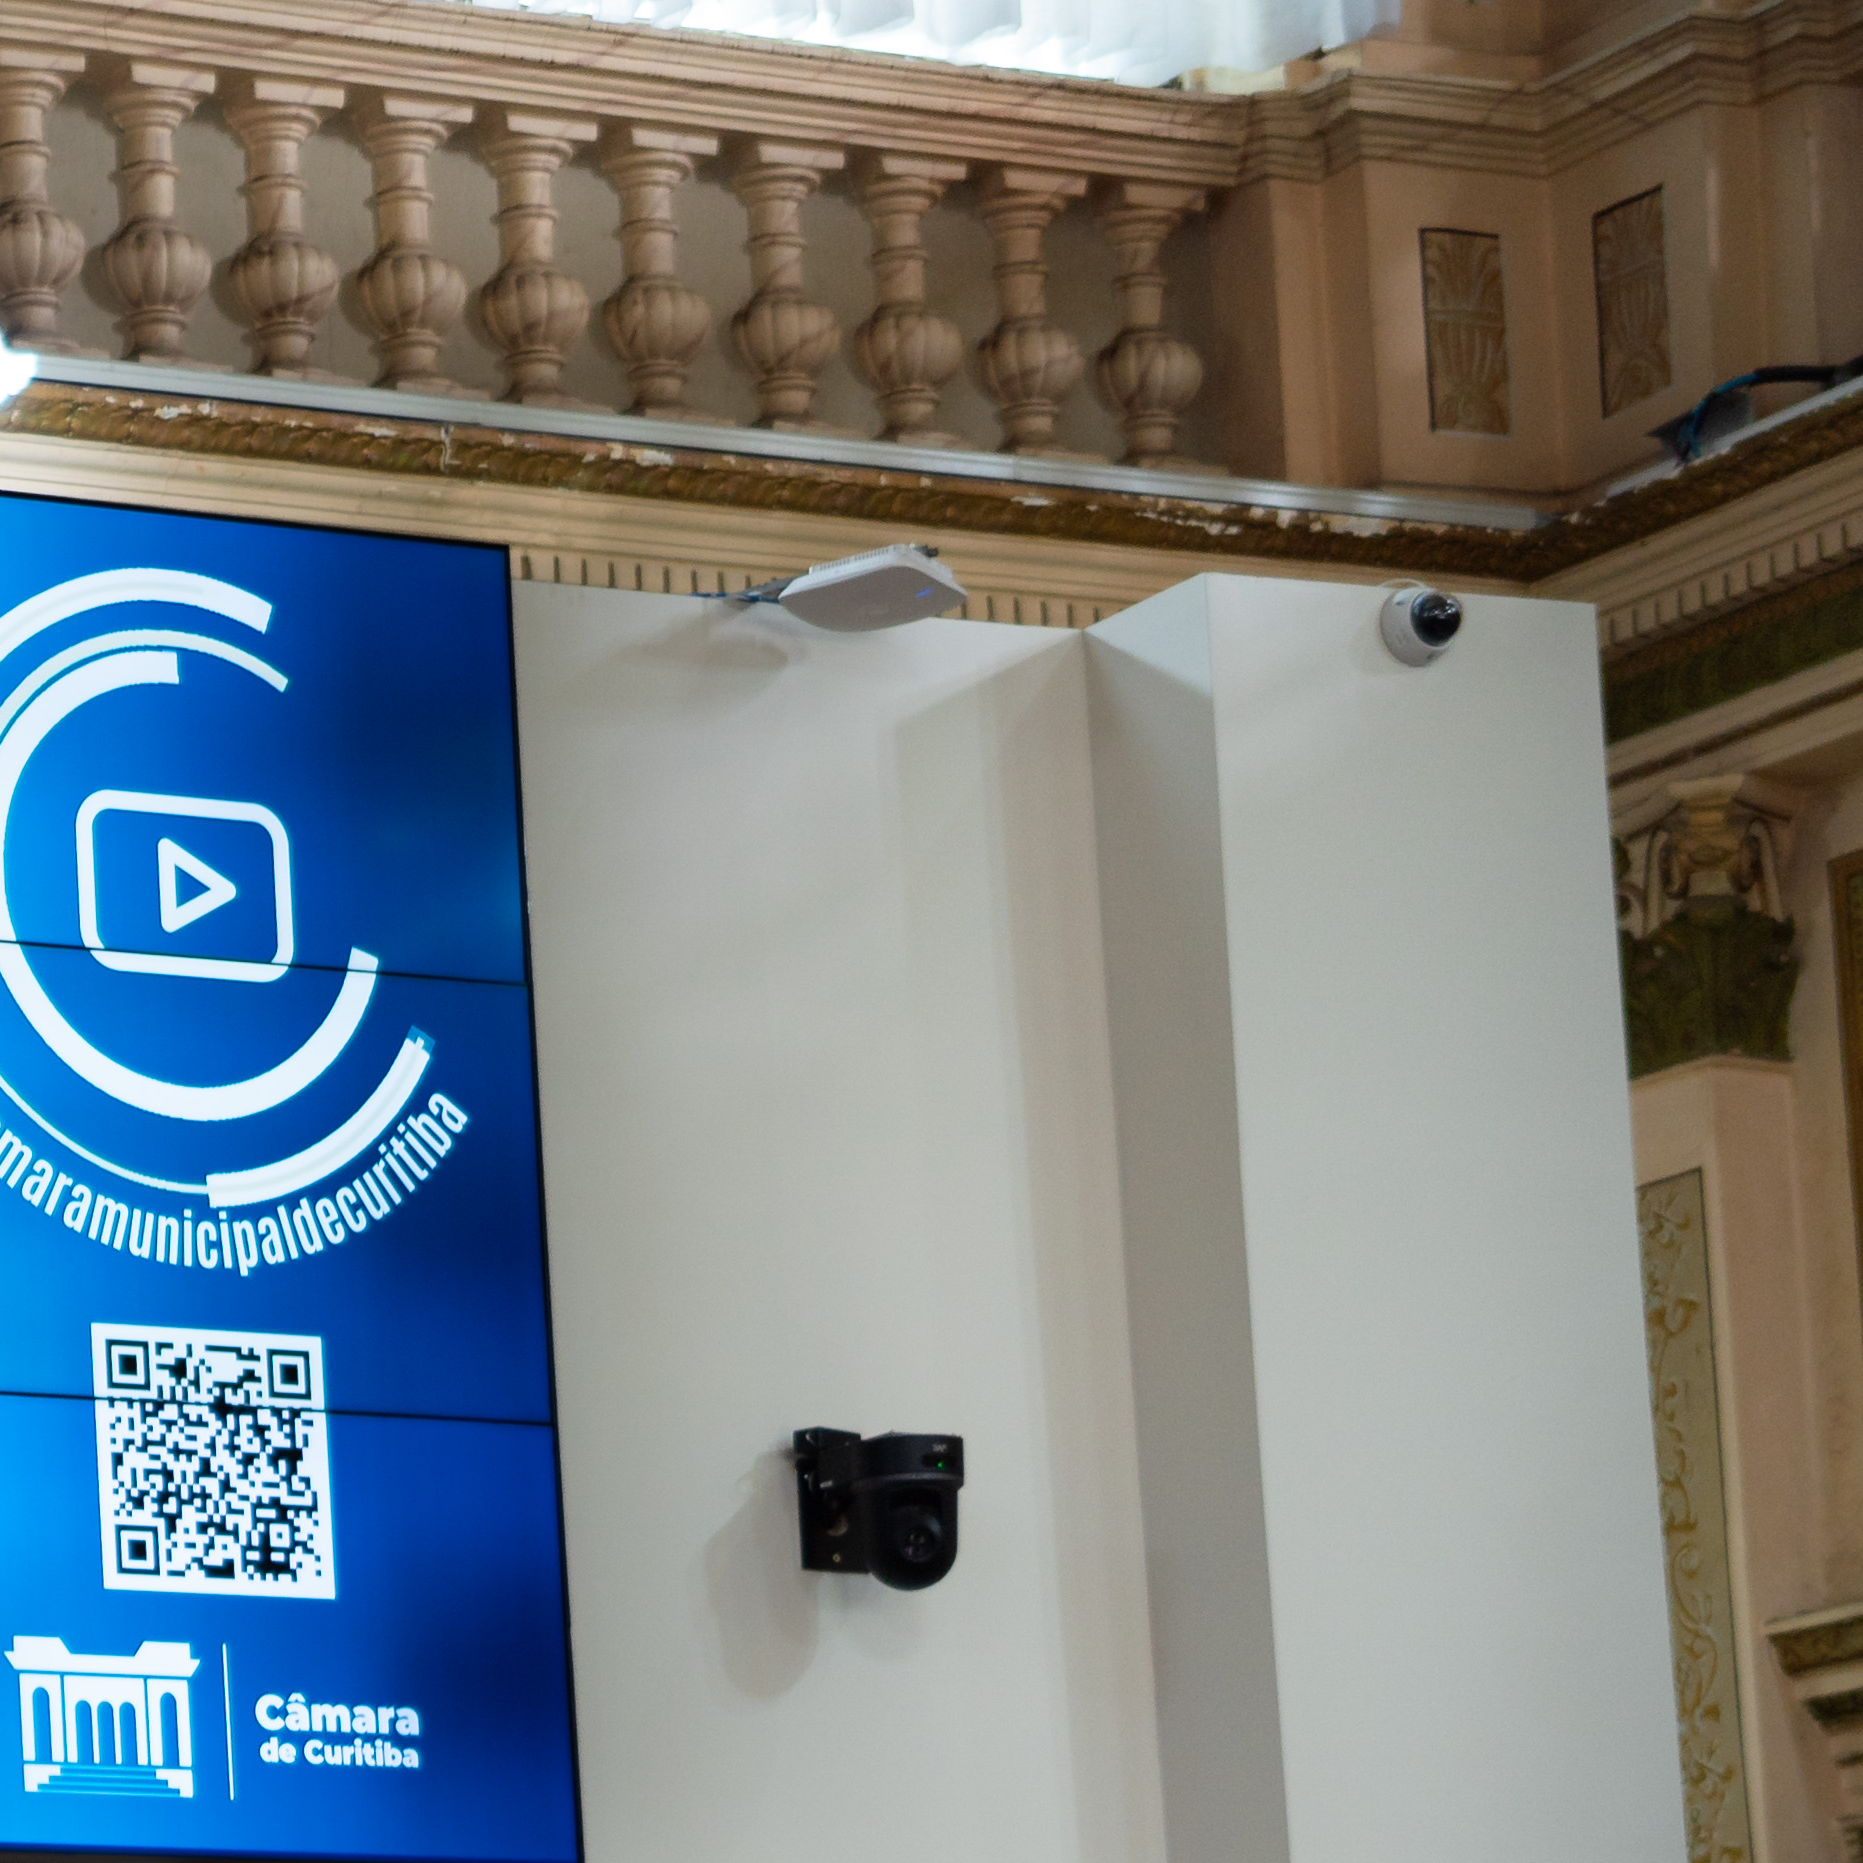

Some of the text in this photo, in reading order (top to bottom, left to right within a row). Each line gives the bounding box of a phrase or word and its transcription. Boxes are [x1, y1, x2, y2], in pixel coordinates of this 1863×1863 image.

[255, 1693, 419, 1735] Câmara
[260, 1737, 418, 1767] de Curitiba
